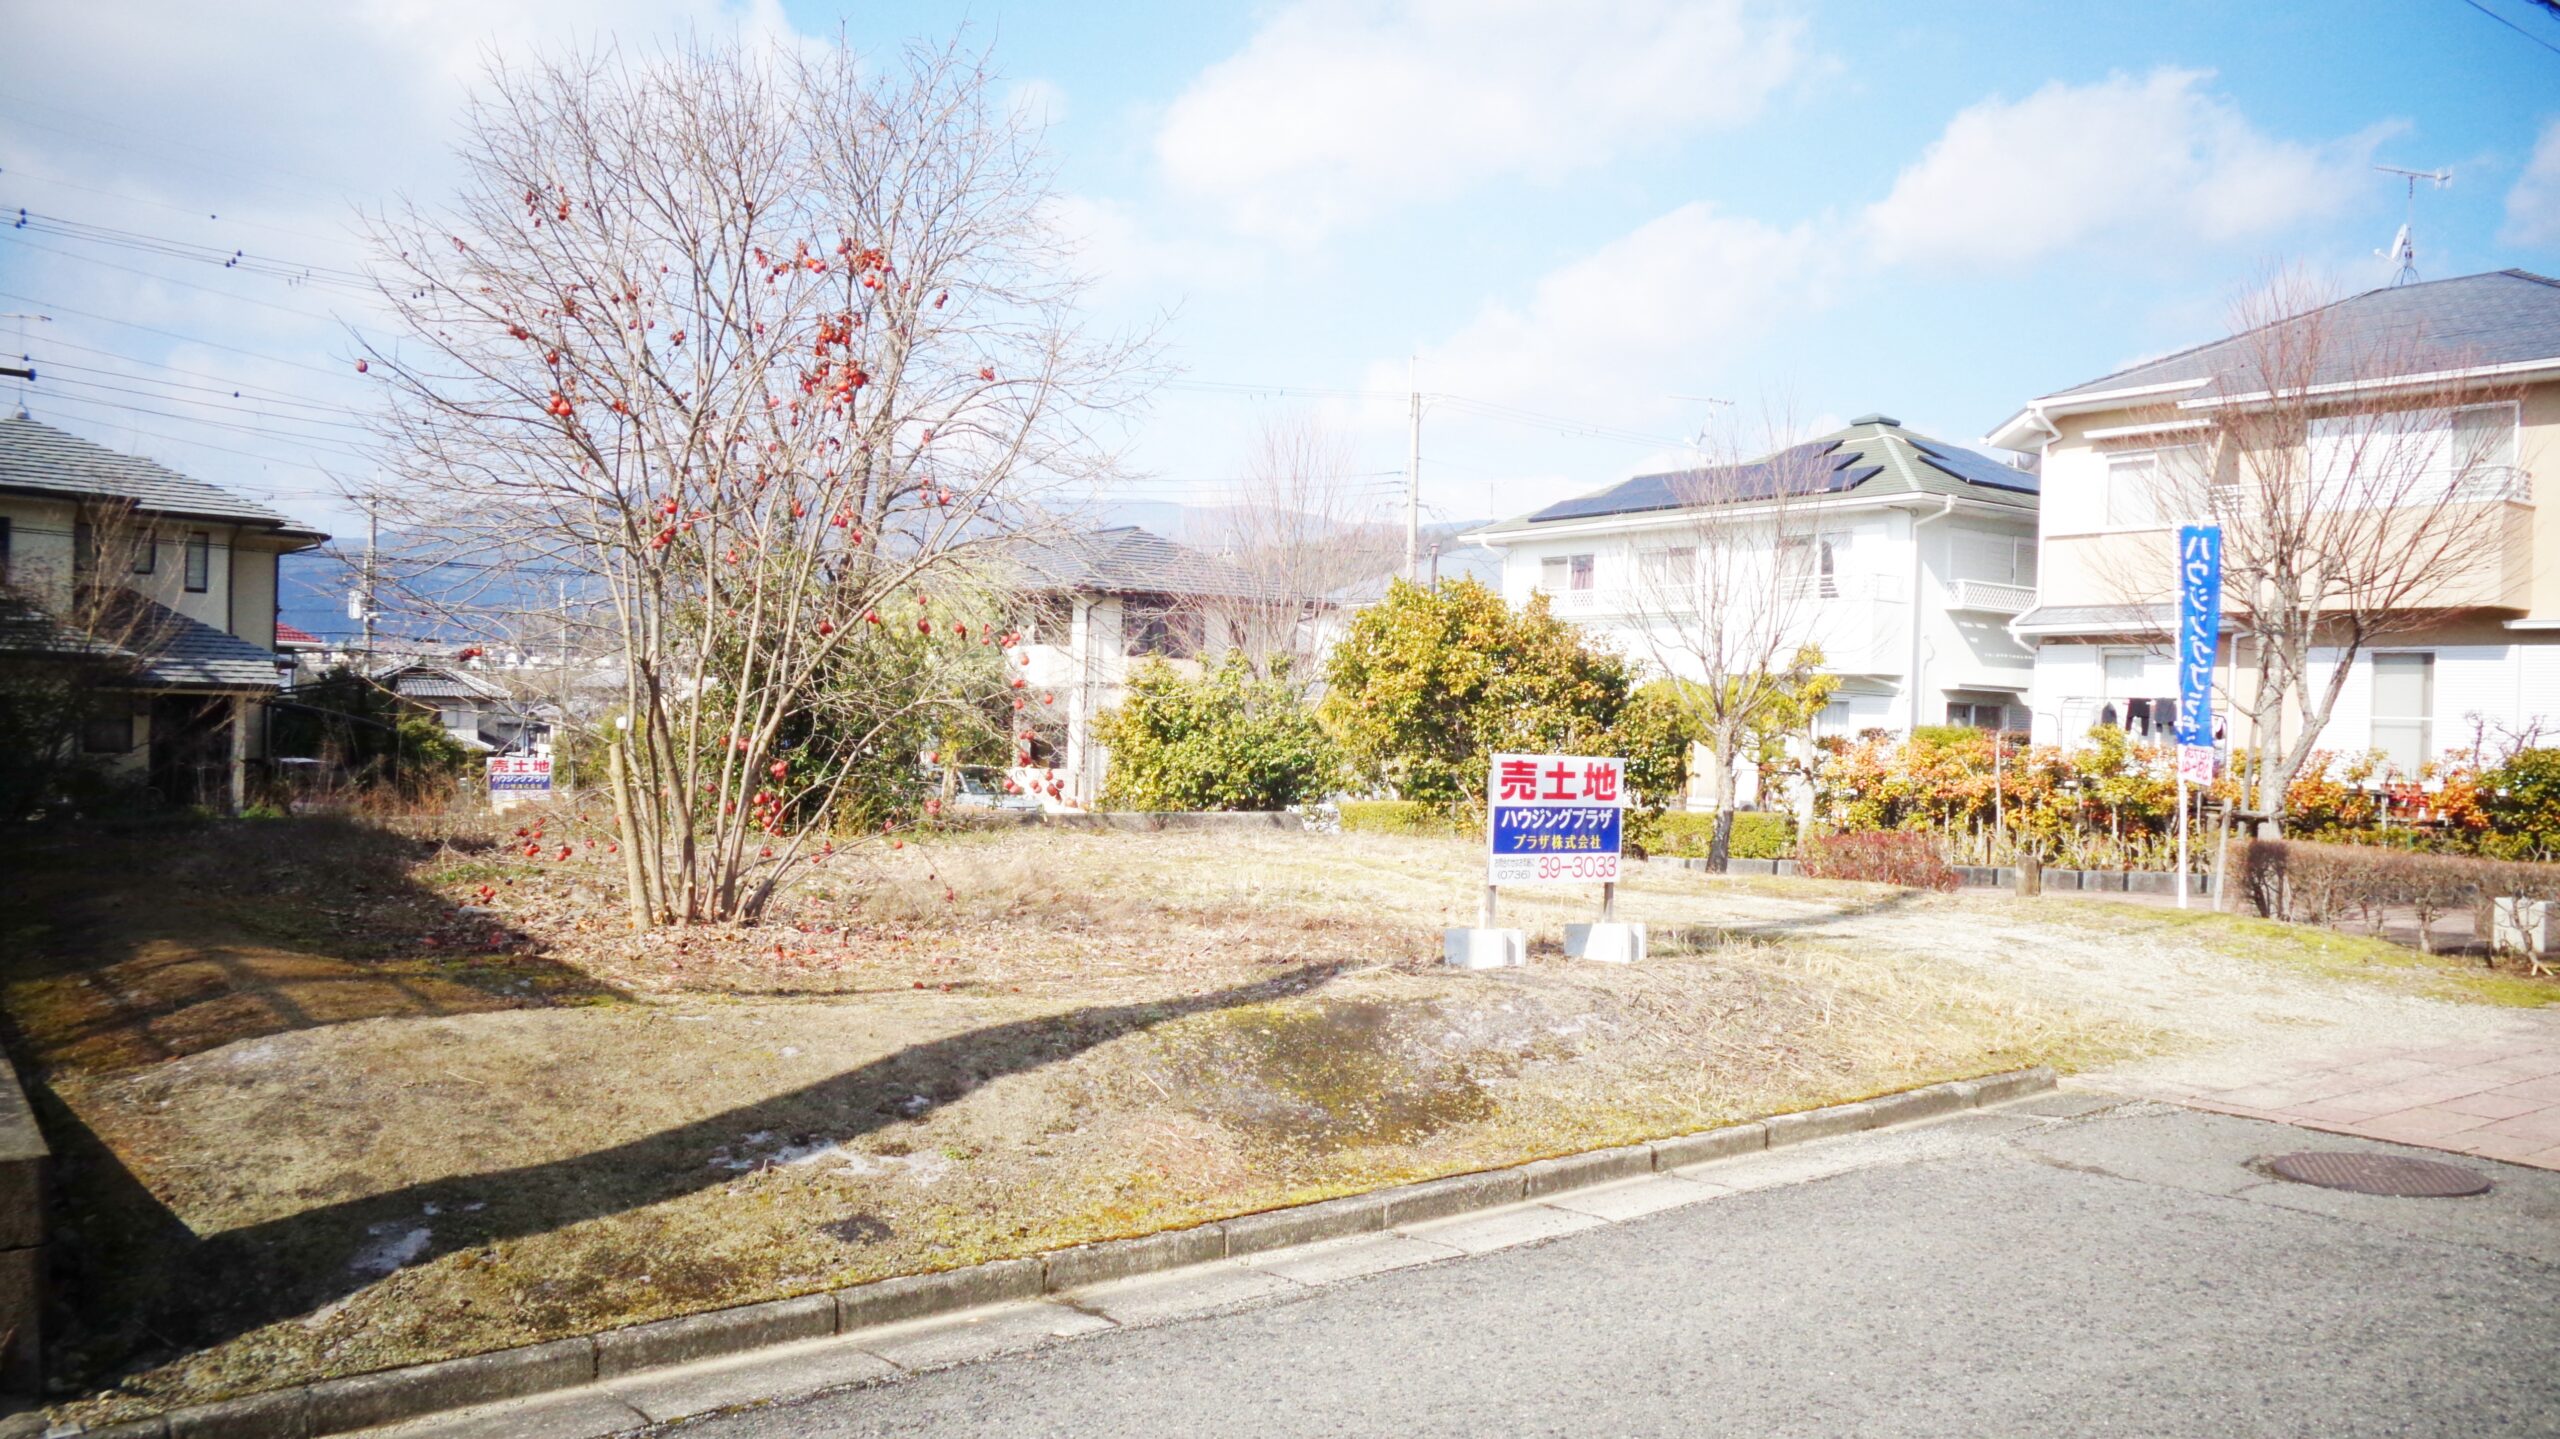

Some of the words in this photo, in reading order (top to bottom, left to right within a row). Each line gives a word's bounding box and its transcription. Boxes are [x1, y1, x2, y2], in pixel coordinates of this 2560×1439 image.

[491, 759, 550, 773] 売土地
[1500, 760, 1617, 801] 売土地
[1501, 808, 1613, 829] ハウジングプラザ
[1513, 834, 1601, 850] プラザ株式会社
[1497, 870, 1531, 880] (0736)
[1538, 856, 1617, 879] 39-3033
